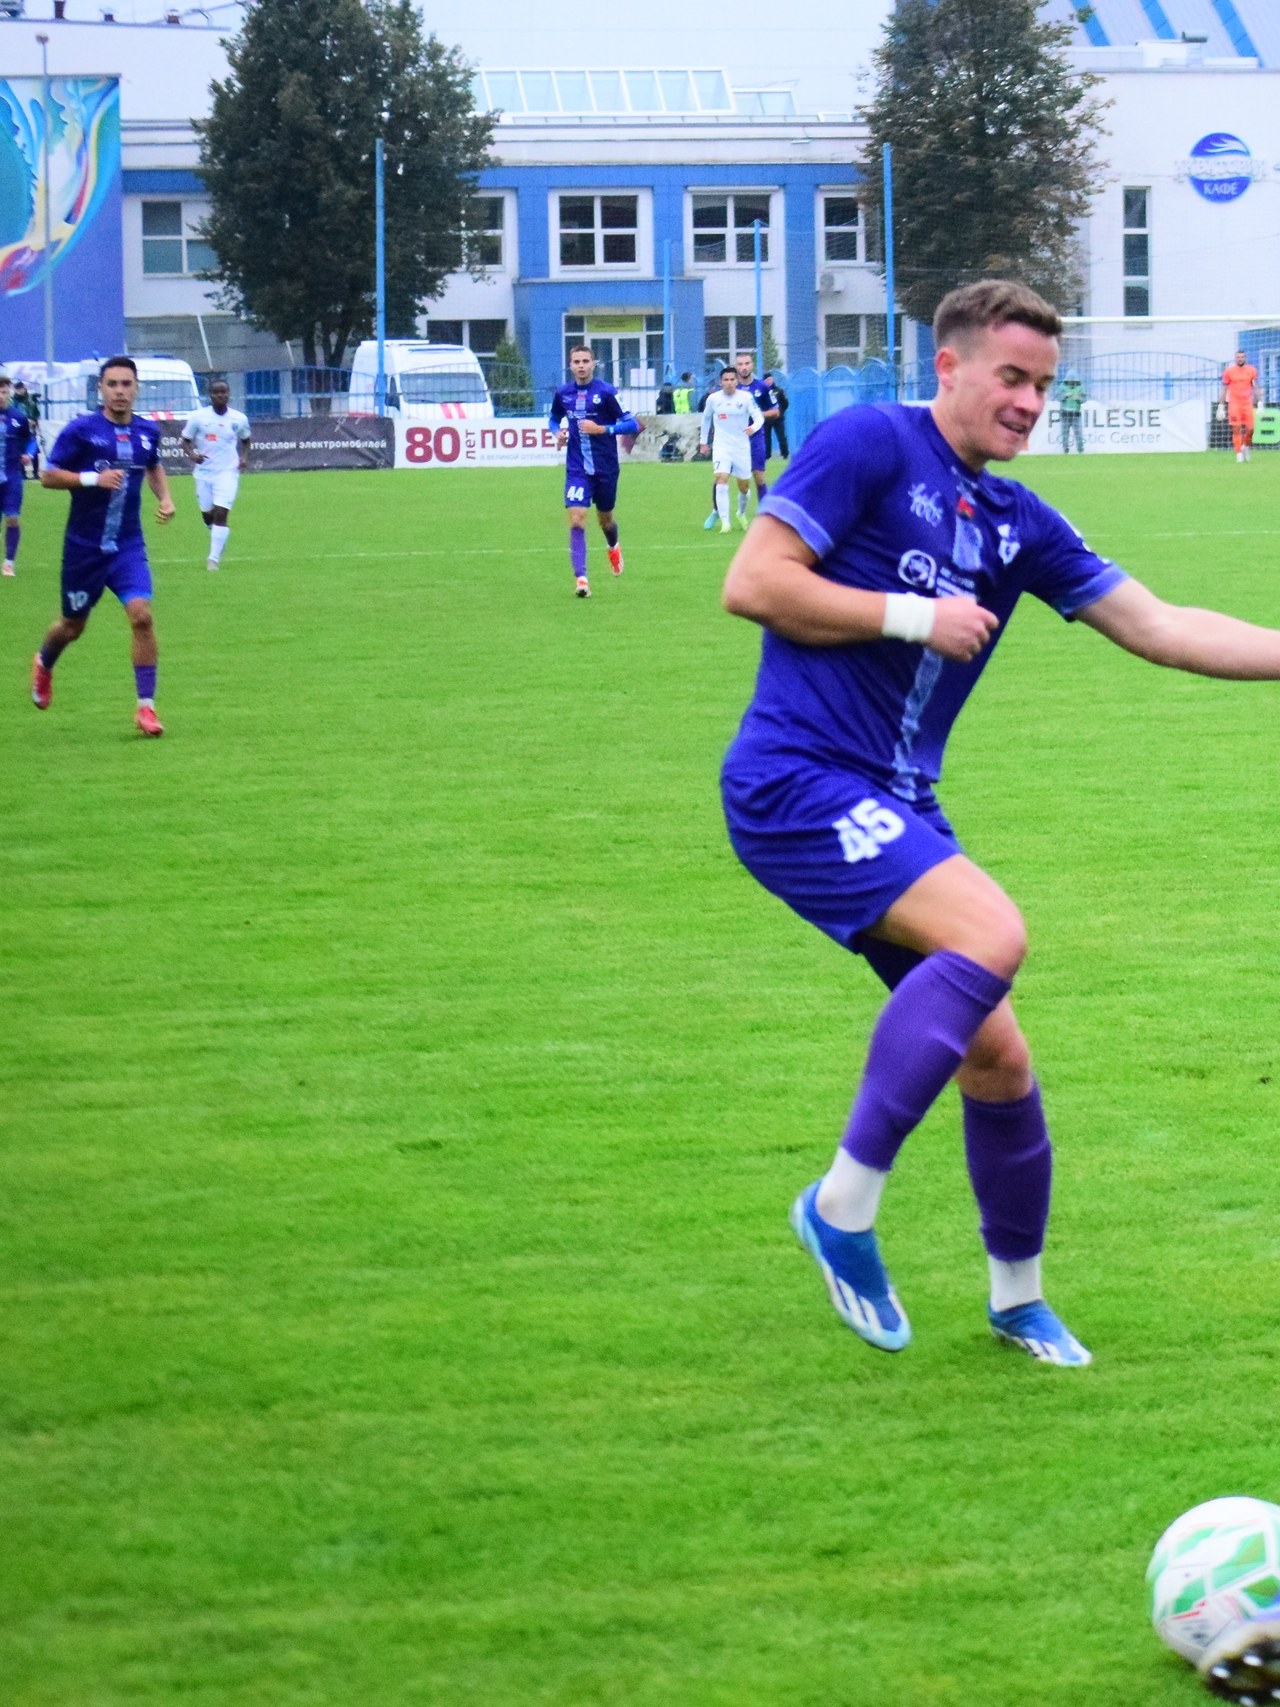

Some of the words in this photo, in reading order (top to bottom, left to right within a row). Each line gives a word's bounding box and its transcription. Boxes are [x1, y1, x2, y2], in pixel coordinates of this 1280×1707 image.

[1203, 182, 1238, 195] КАФЕ
[1048, 409, 1161, 428] PILESIE
[249, 440, 297, 450] тосалон
[298, 439, 387, 451] электромобилей
[405, 426, 461, 463] 80
[465, 428, 476, 460] лет
[480, 428, 569, 451] ПОБЕ
[1048, 430, 1106, 446] Logstic
[1110, 430, 1161, 444] Center
[566, 485, 584, 502] 44
[832, 798, 906, 863] 45
